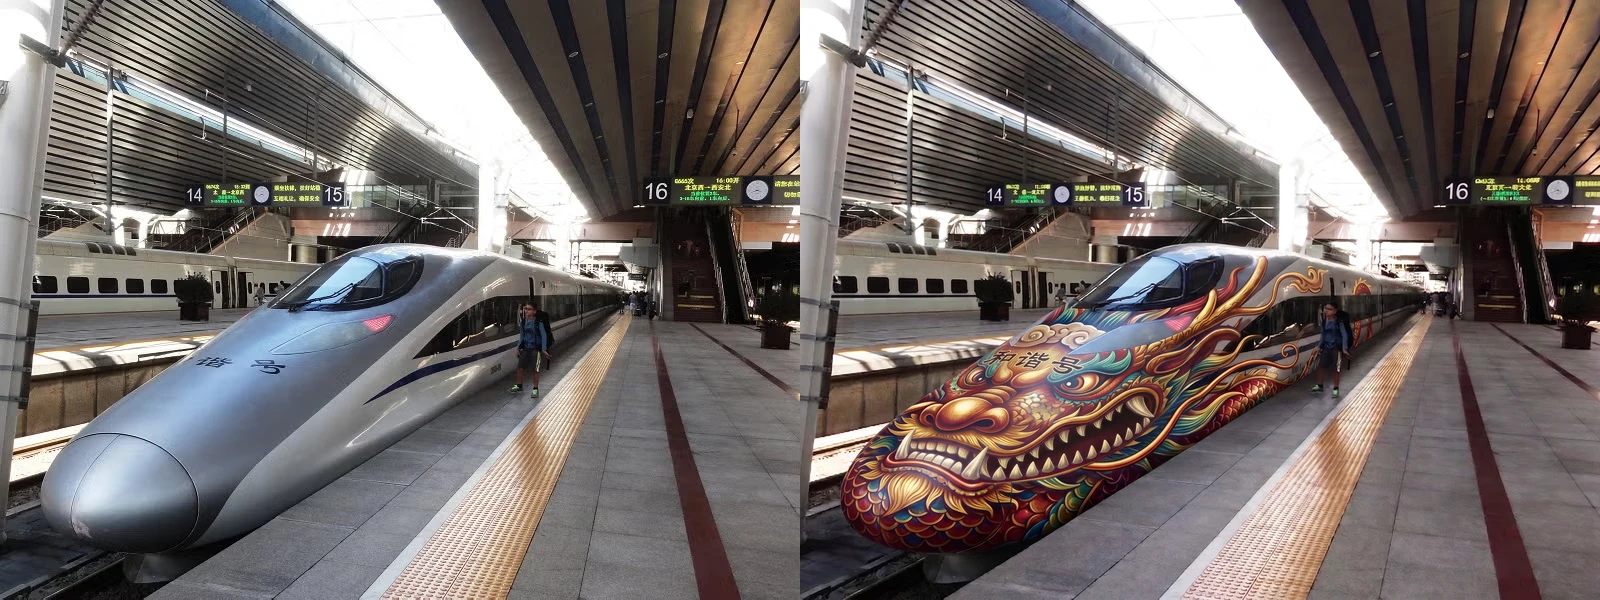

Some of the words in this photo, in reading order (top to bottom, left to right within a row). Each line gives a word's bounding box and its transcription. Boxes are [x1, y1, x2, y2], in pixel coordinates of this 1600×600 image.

[187, 188, 202, 202] 14
[325, 187, 342, 202] 15
[646, 183, 668, 200] 16
[987, 188, 1002, 202] 14
[1125, 187, 1143, 202] 15
[1446, 183, 1469, 200] 16
[984, 350, 1083, 374] 和谐号
